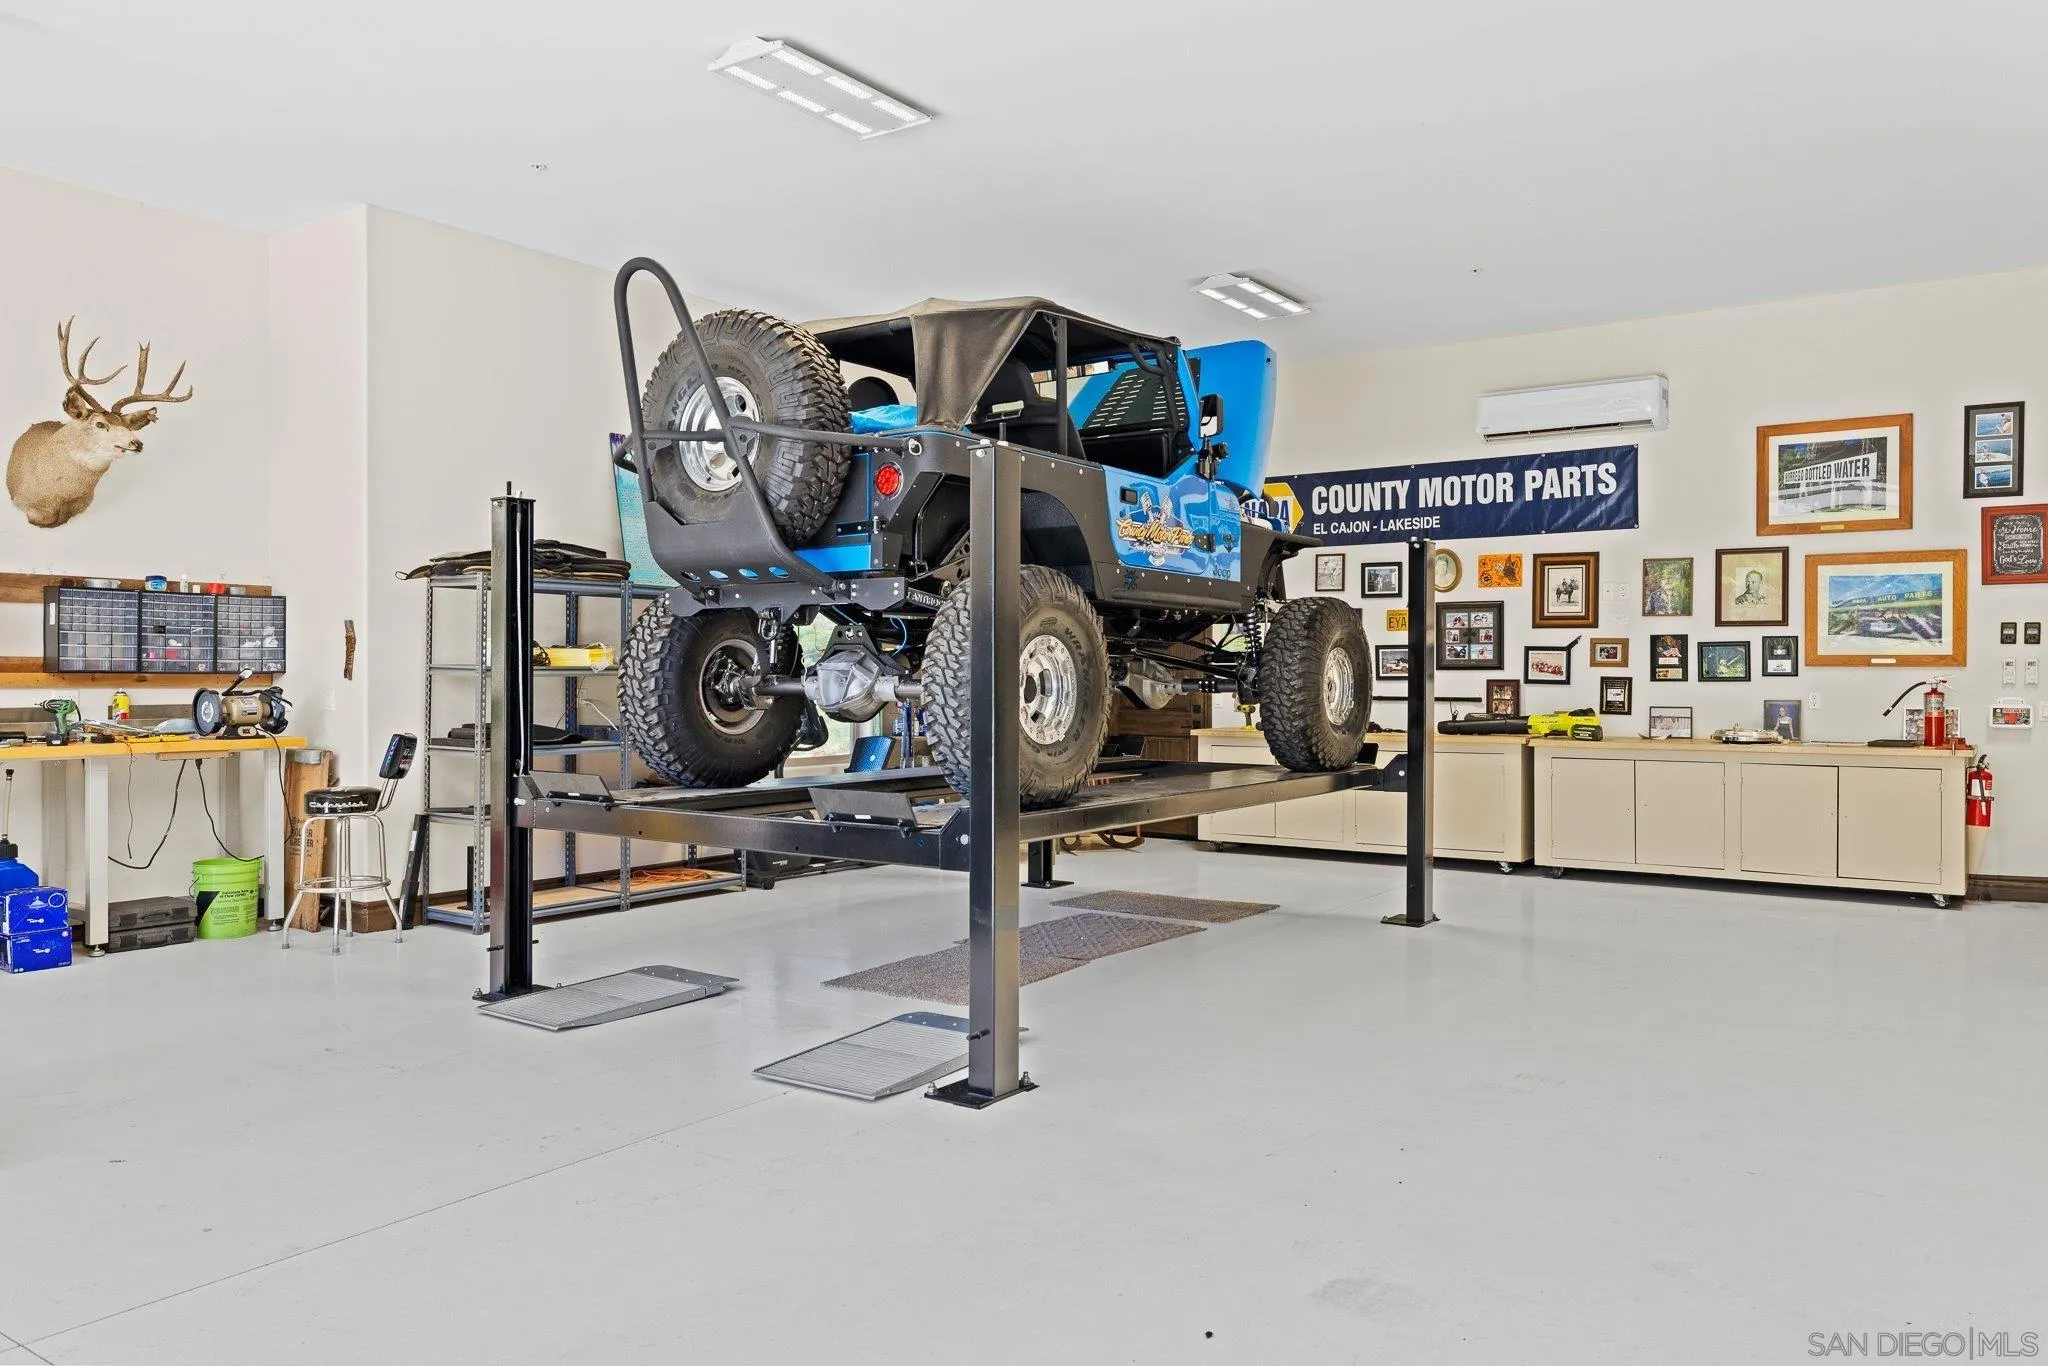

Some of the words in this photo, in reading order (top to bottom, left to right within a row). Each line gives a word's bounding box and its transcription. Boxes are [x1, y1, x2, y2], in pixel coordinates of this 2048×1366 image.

[1804, 464, 1832, 481] BOTTLED
[1834, 457, 1870, 479] WATER
[1311, 479, 1411, 515] COUNTY
[1418, 472, 1514, 508] MOTOR
[1524, 462, 1617, 502] PARTS
[1313, 523, 1328, 535] EL
[1330, 520, 1370, 534] CAJON
[1380, 515, 1440, 532] LAKESIDE
[1878, 594, 1897, 602] AUTO
[1904, 590, 1933, 599] PARTS
